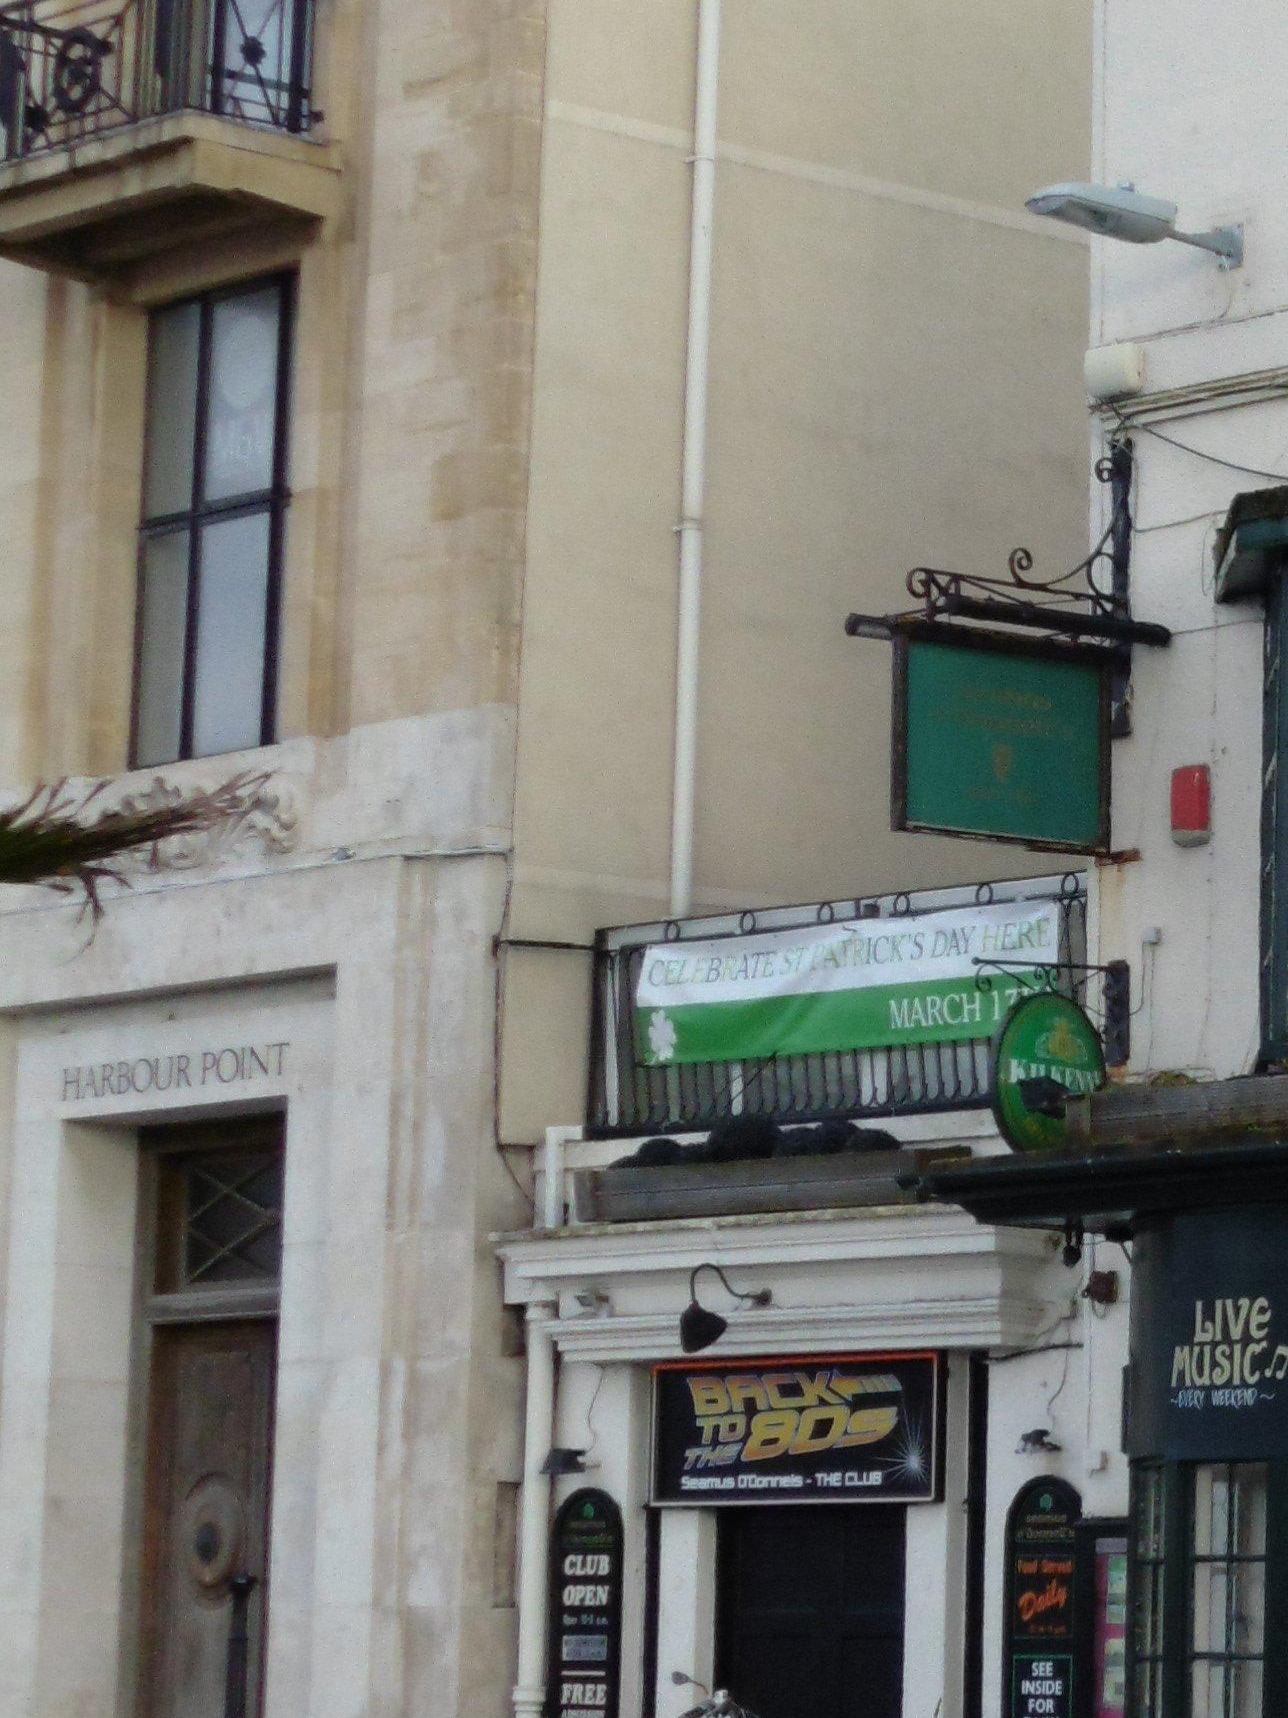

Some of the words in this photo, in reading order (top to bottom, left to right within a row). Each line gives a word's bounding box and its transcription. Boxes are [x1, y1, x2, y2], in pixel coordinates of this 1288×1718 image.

[649, 951, 775, 987] CELEBRATE
[808, 931, 925, 973] PATRICK'S
[929, 925, 978, 959] DAY
[980, 917, 1052, 952] HERE
[889, 994, 981, 1030] MARCH
[62, 1052, 192, 1102] HARBOUR
[202, 1042, 291, 1084] POINT
[1193, 1297, 1272, 1343] LIVE
[1171, 1340, 1268, 1388] MUSIC
[687, 1371, 847, 1416] BACK
[696, 1413, 748, 1444] TO
[683, 1442, 744, 1471] THE
[681, 1474, 735, 1490] Seamus
[815, 1471, 842, 1487] THE
[844, 1470, 883, 1486] CLUB
[564, 1554, 611, 1576] CLUB
[562, 1584, 610, 1607] OPEN
[1031, 1661, 1054, 1677] SEE
[560, 1683, 607, 1706] FREE
[1021, 1680, 1063, 1696] INSIDE
[1027, 1698, 1055, 1714] FOR
